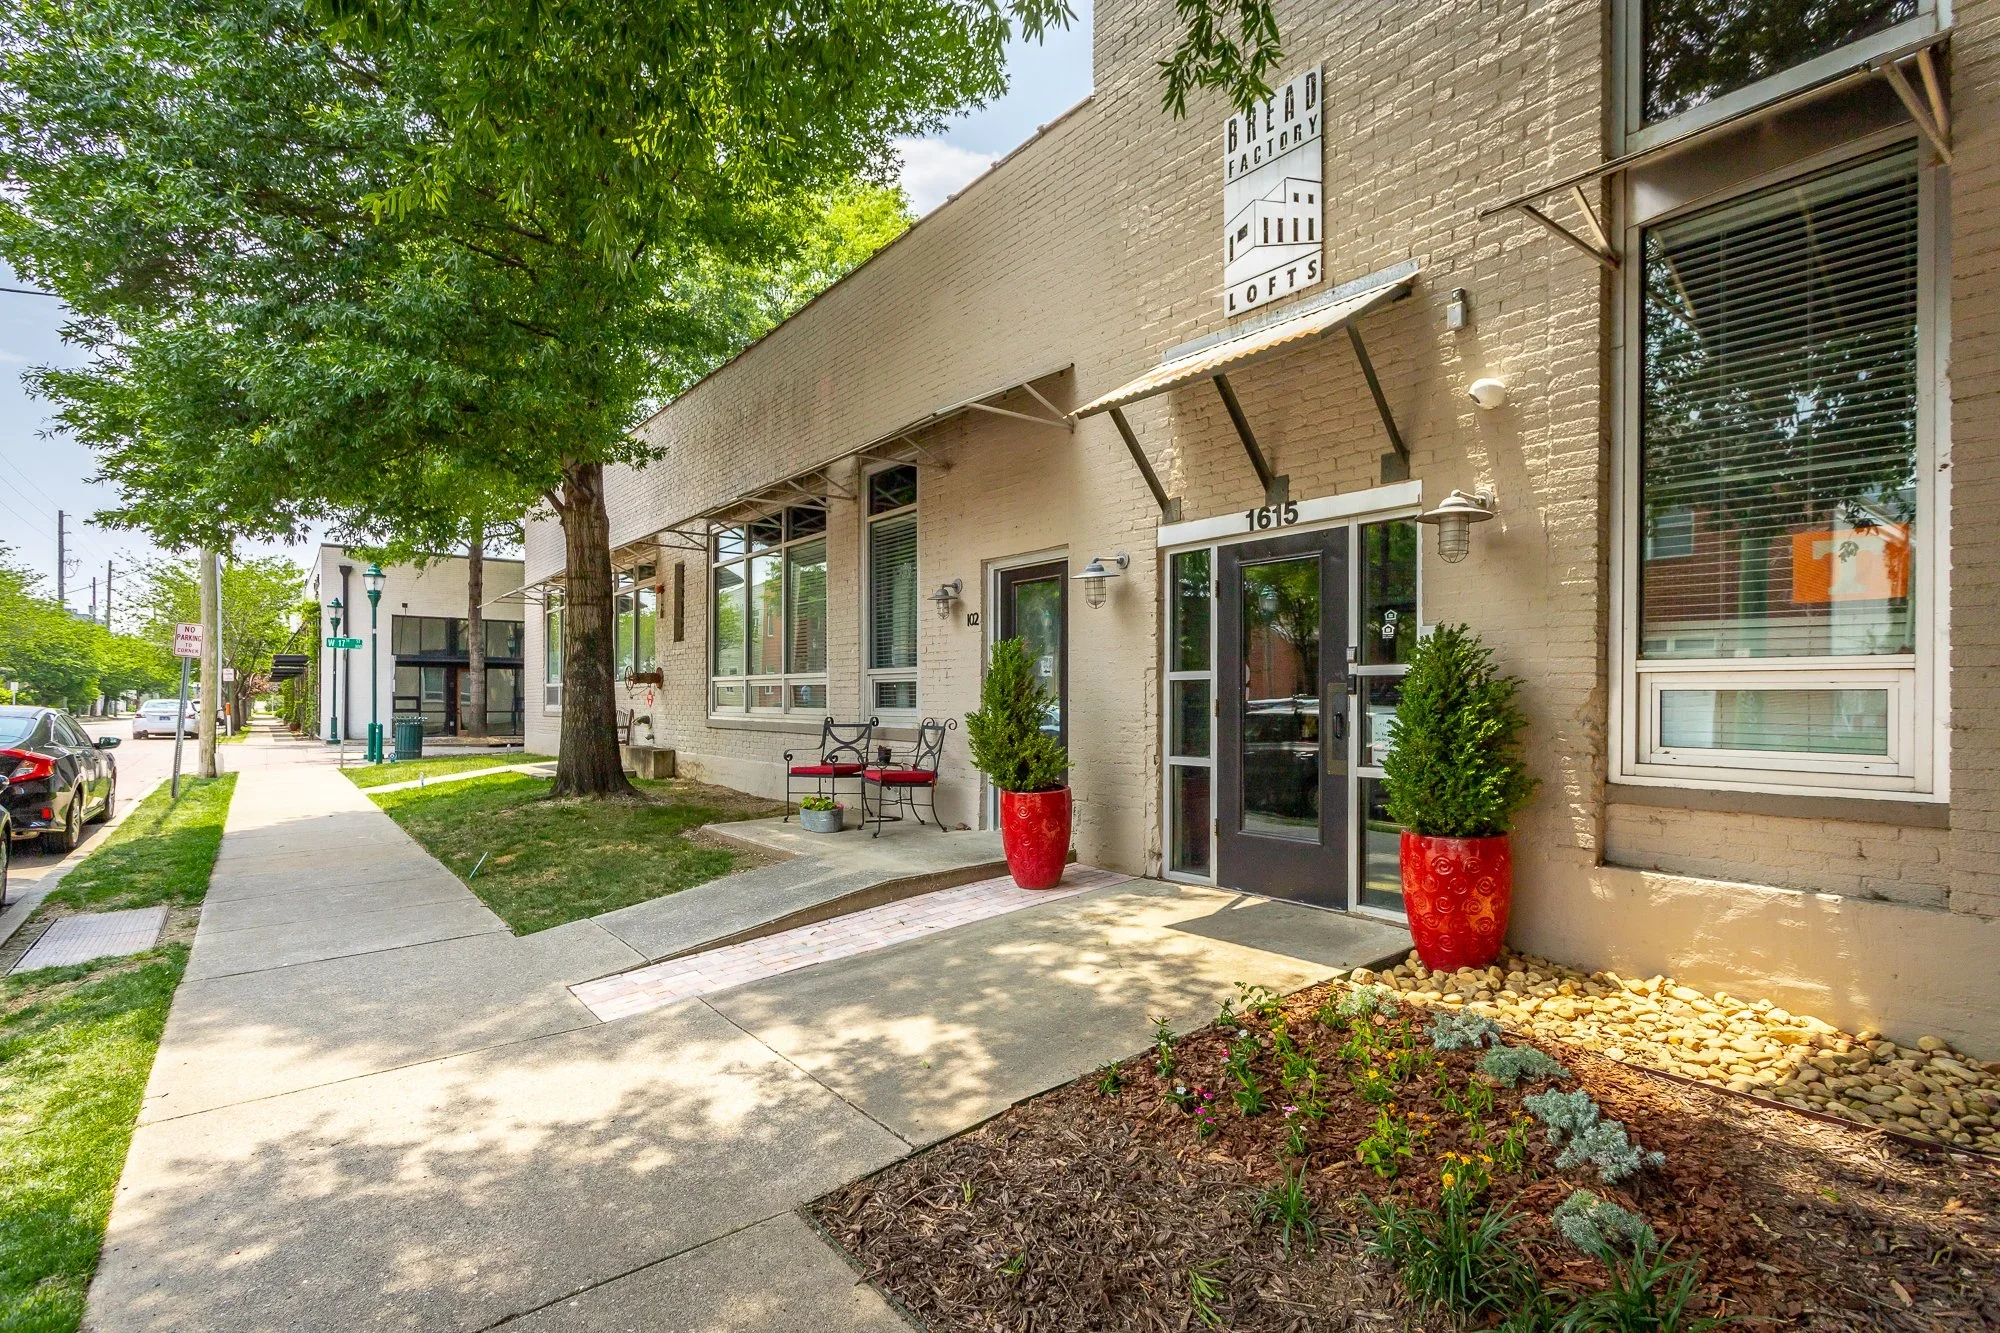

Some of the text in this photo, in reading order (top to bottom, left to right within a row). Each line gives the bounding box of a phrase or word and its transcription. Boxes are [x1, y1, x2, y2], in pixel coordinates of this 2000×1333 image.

[1228, 72, 1317, 154] BREAD
[1229, 114, 1317, 178] FACTORY
[1229, 259, 1317, 311] LOFTS
[1245, 500, 1299, 531] 1615
[967, 612, 979, 627] 102
[176, 634, 202, 642] PARKING
[328, 639, 335, 647] W
